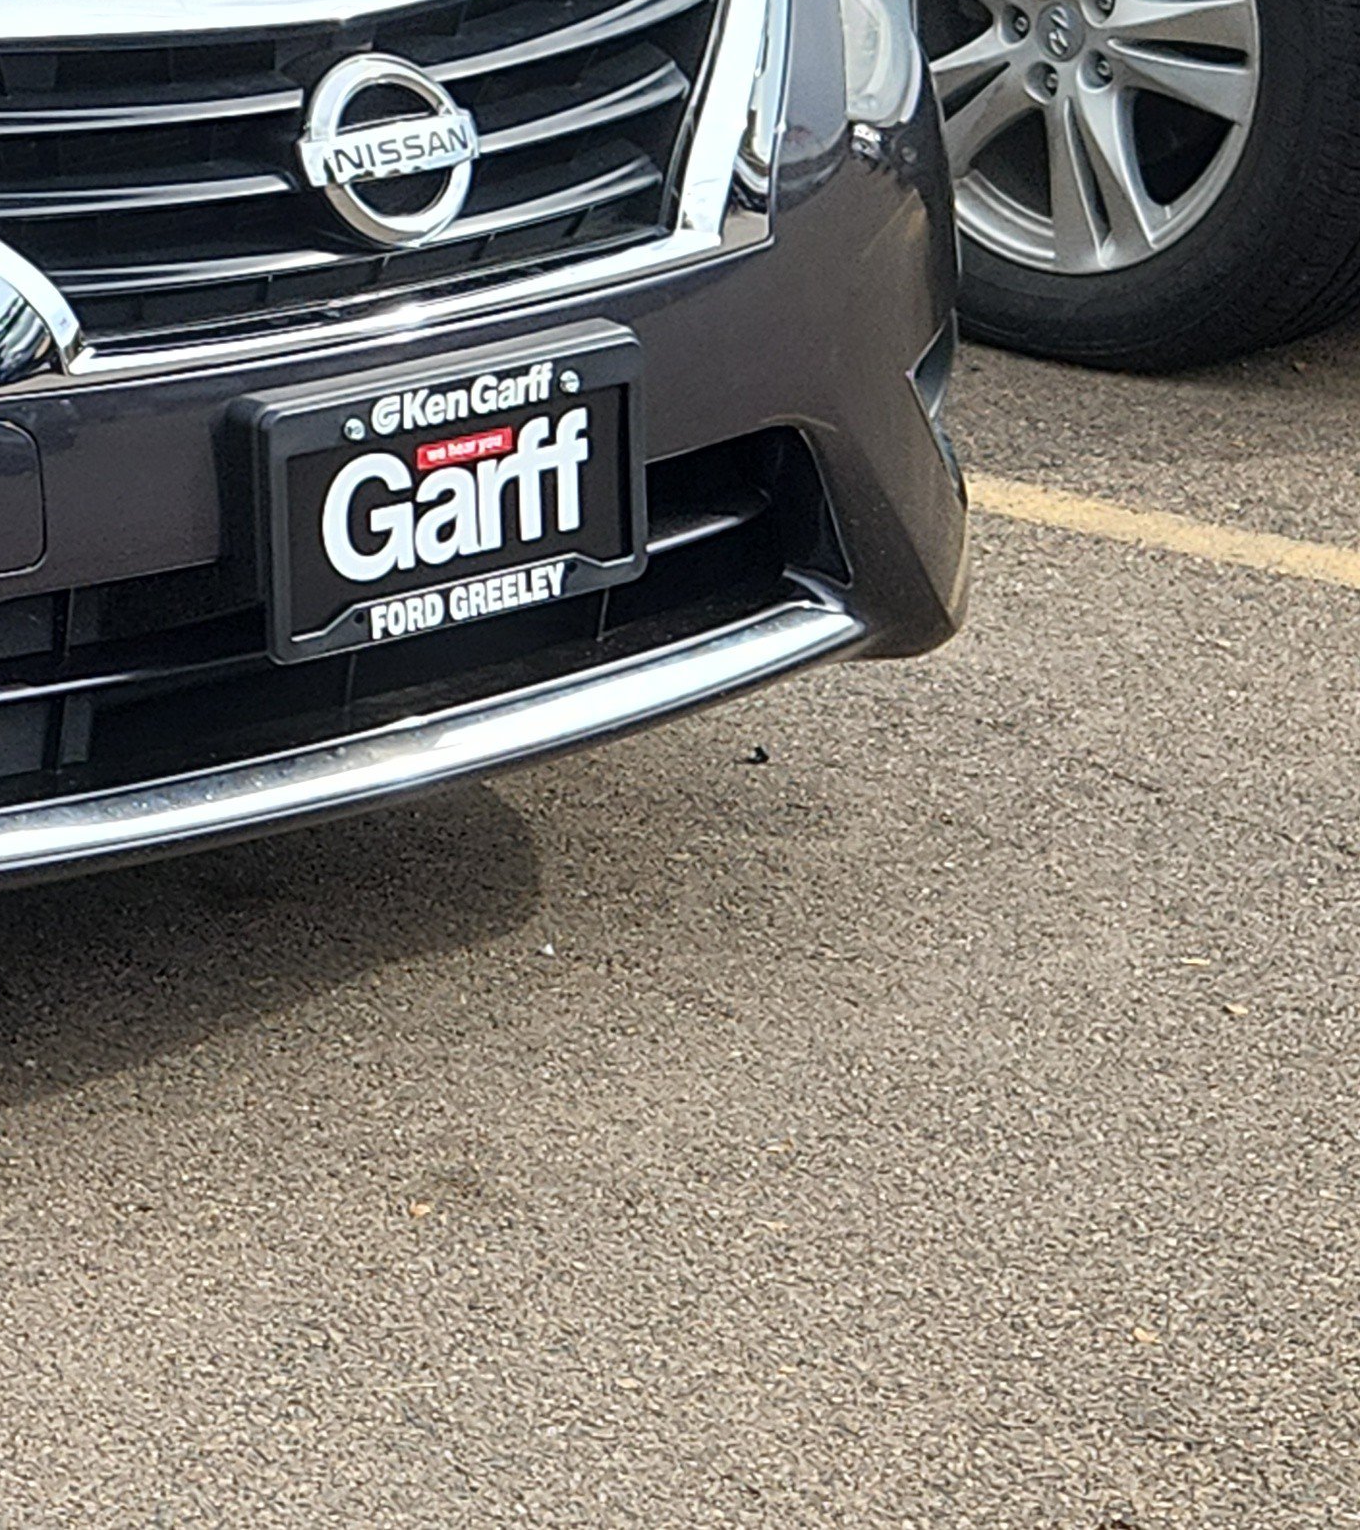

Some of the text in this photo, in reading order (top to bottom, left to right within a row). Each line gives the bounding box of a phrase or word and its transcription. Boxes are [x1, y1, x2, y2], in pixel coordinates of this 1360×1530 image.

[333, 124, 469, 173] NISSAN
[403, 361, 553, 430] Ken Garff
[322, 407, 588, 582] Garff
[370, 562, 565, 639] FORD GREELEY
